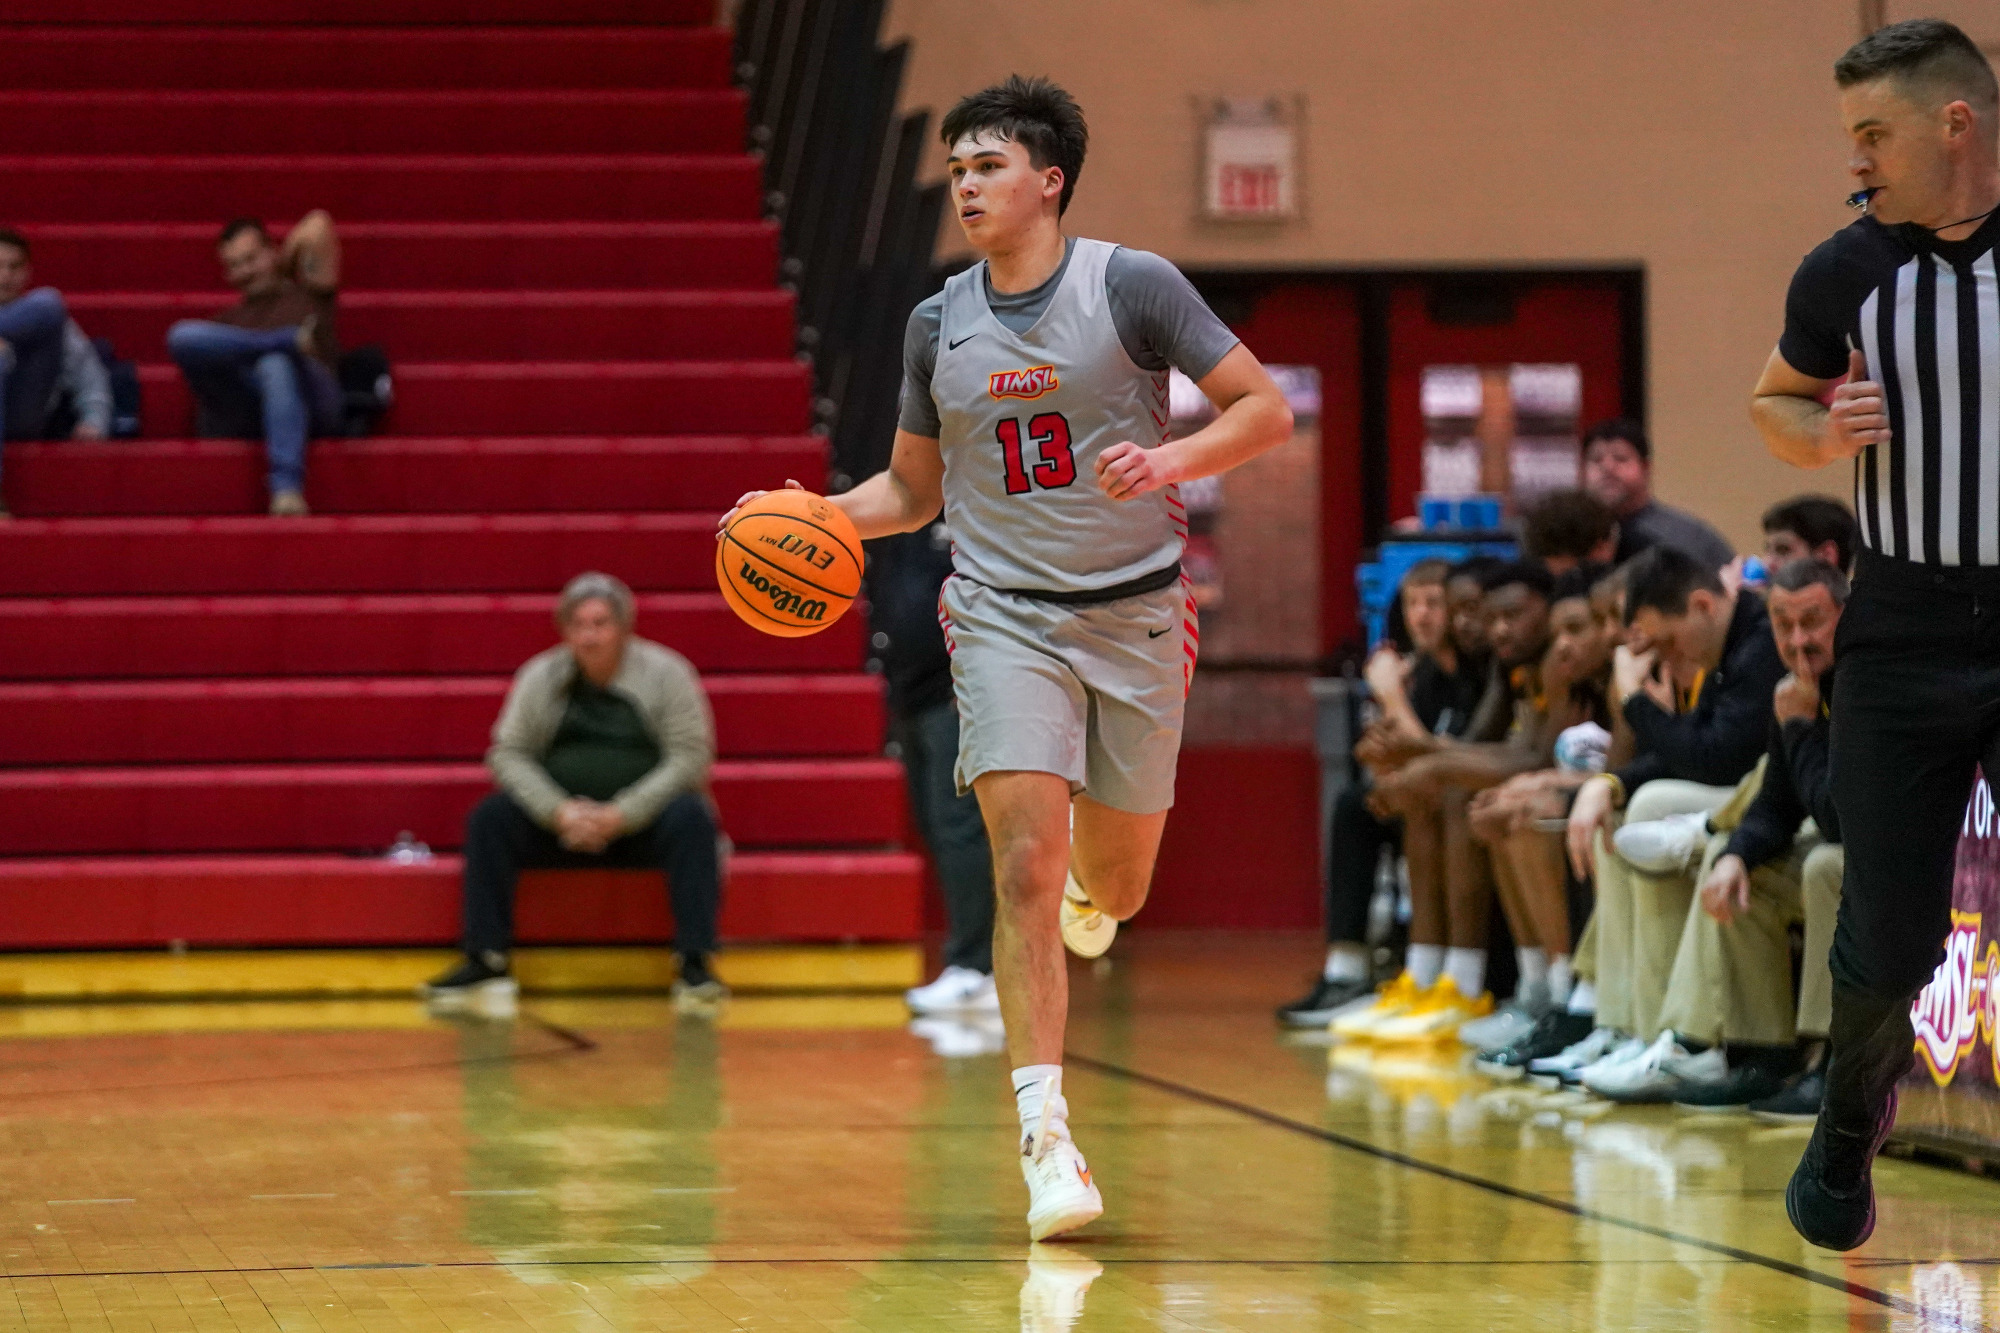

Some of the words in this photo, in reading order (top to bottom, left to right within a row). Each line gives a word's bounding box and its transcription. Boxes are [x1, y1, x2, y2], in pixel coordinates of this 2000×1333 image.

[990, 366, 1058, 398] UMSL
[995, 411, 1077, 495] 13
[758, 535, 778, 546] NXT
[777, 533, 836, 570] EVO
[739, 561, 827, 621] Wilson
